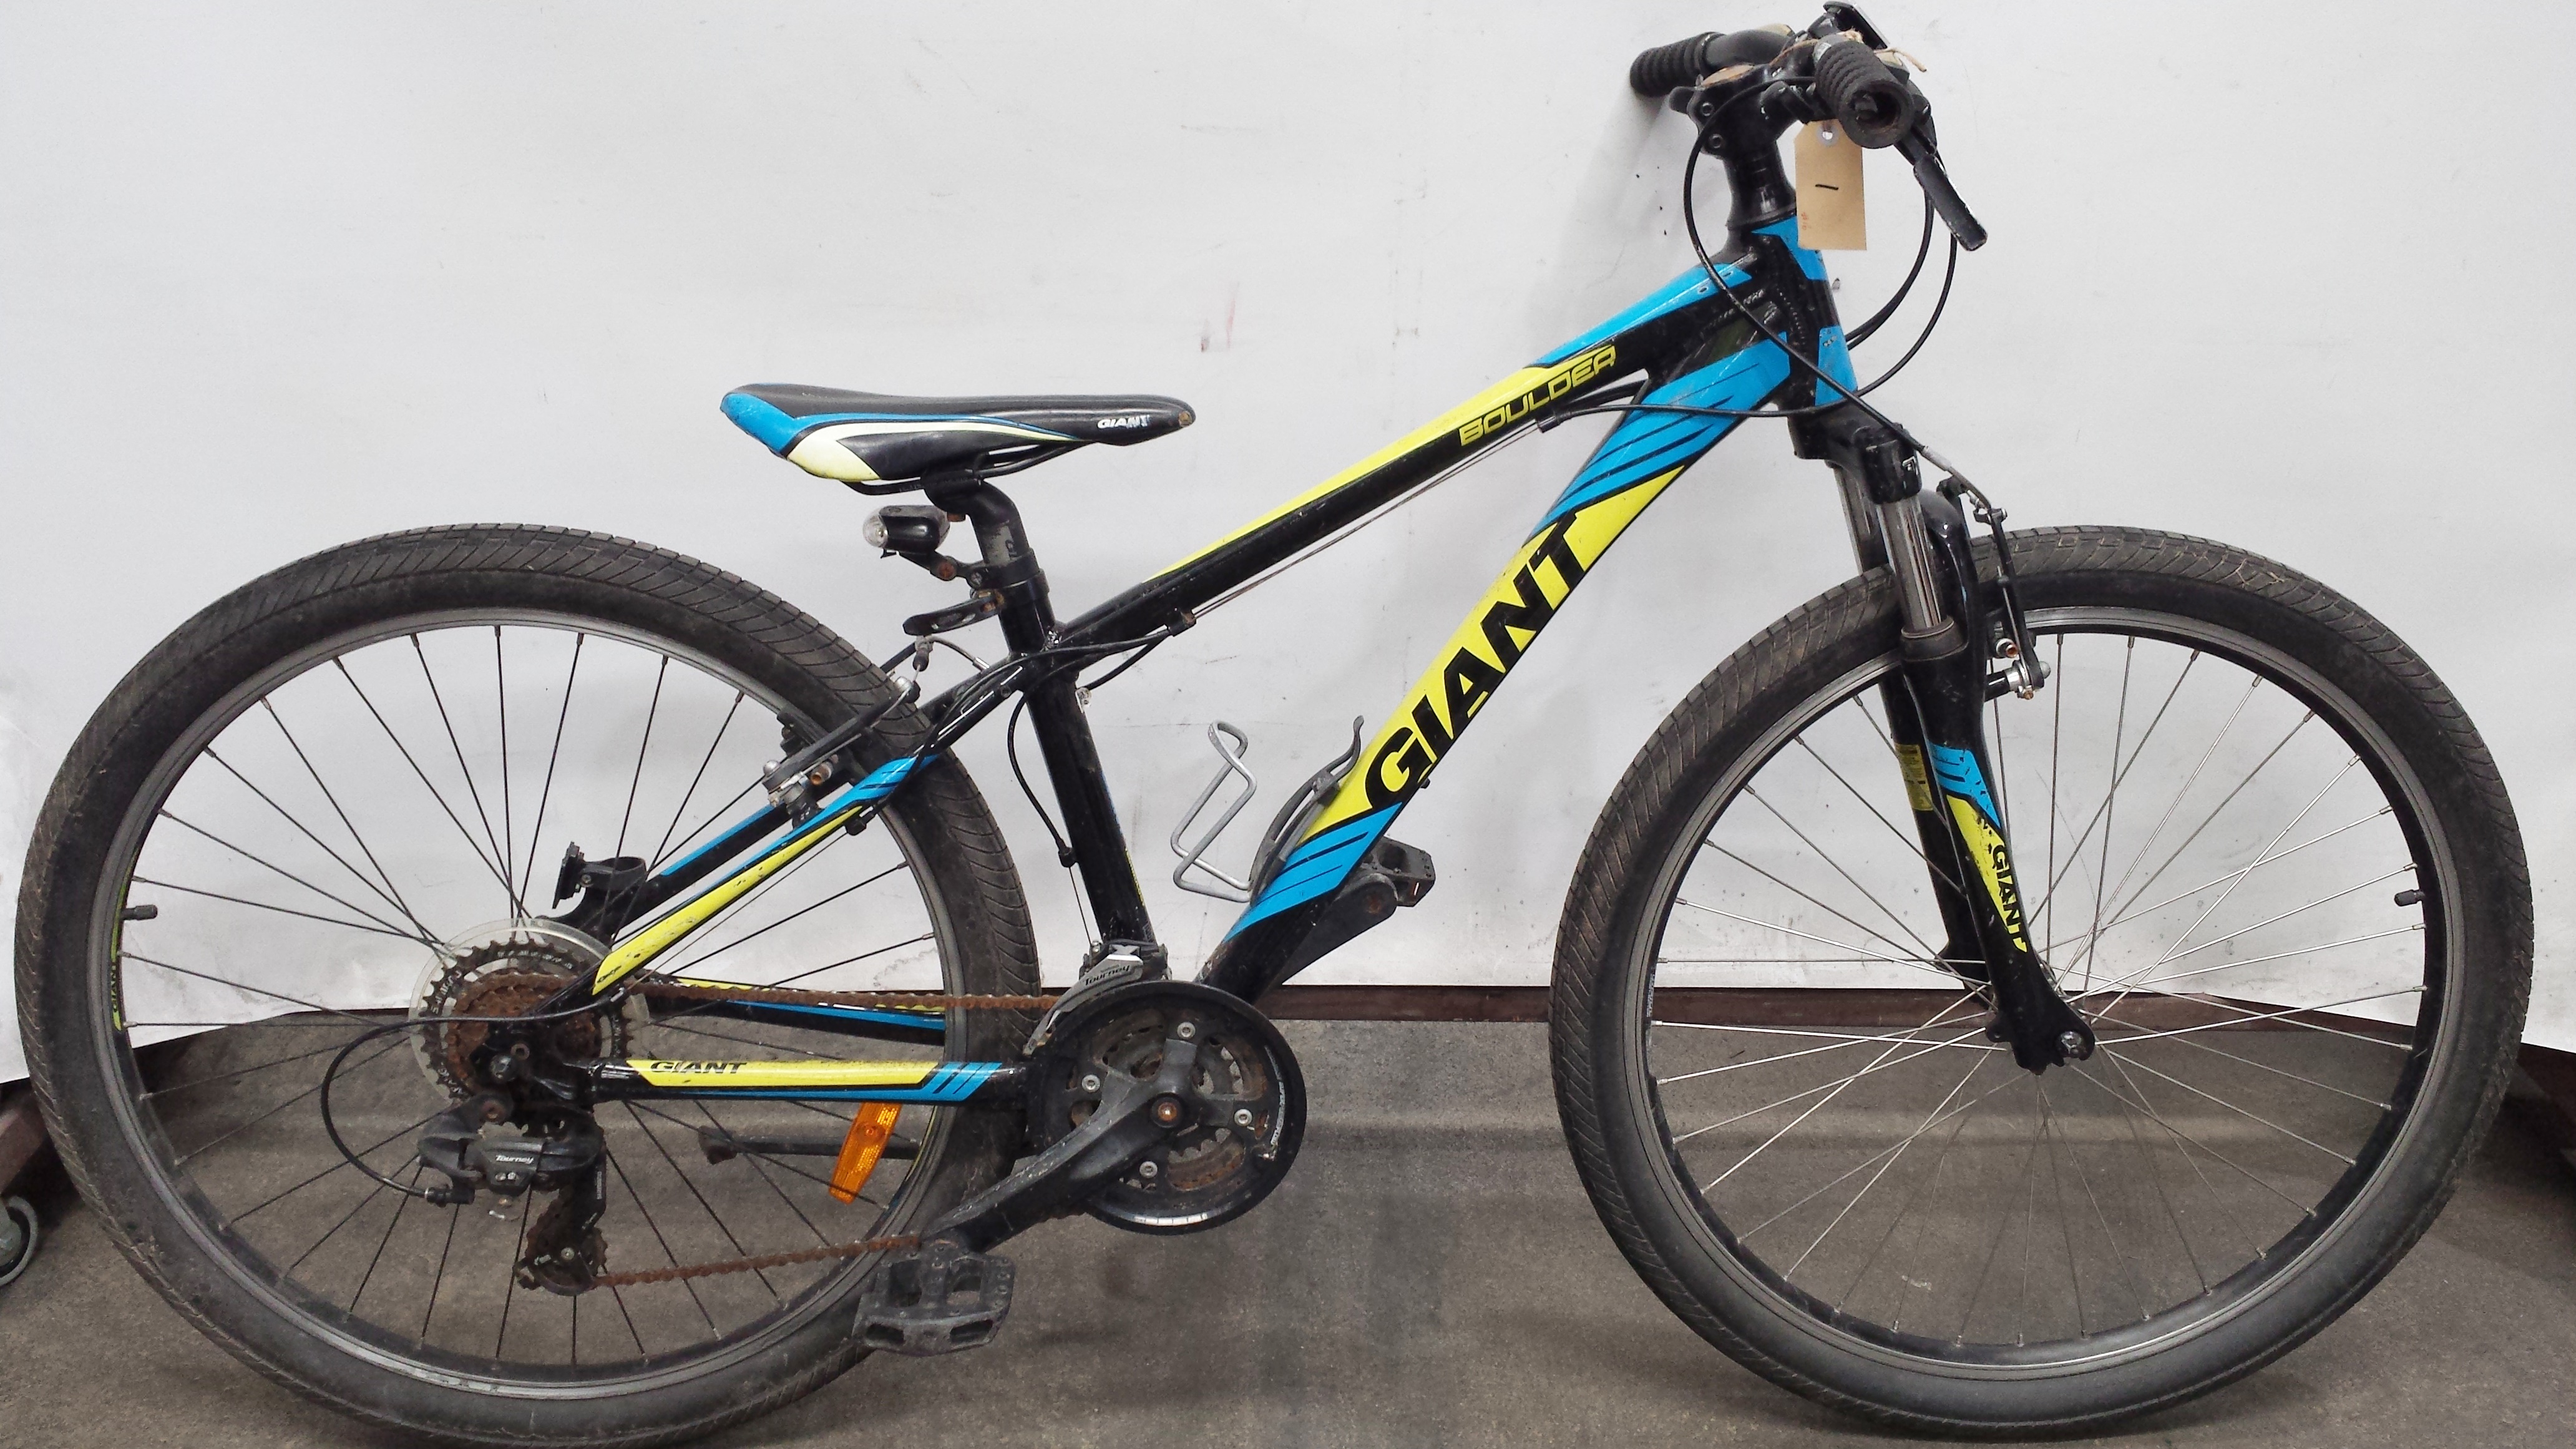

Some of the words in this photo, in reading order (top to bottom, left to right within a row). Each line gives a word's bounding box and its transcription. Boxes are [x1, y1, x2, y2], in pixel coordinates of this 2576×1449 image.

[1459, 344, 1616, 447] BOULDER
[1097, 414, 1150, 429] GIANT
[1365, 508, 1586, 810] GIANT
[1992, 845, 2027, 944] GIANT
[1085, 965, 1130, 986] Tourney
[650, 1062, 747, 1073] GIANT
[495, 1154, 534, 1164] Tourney
